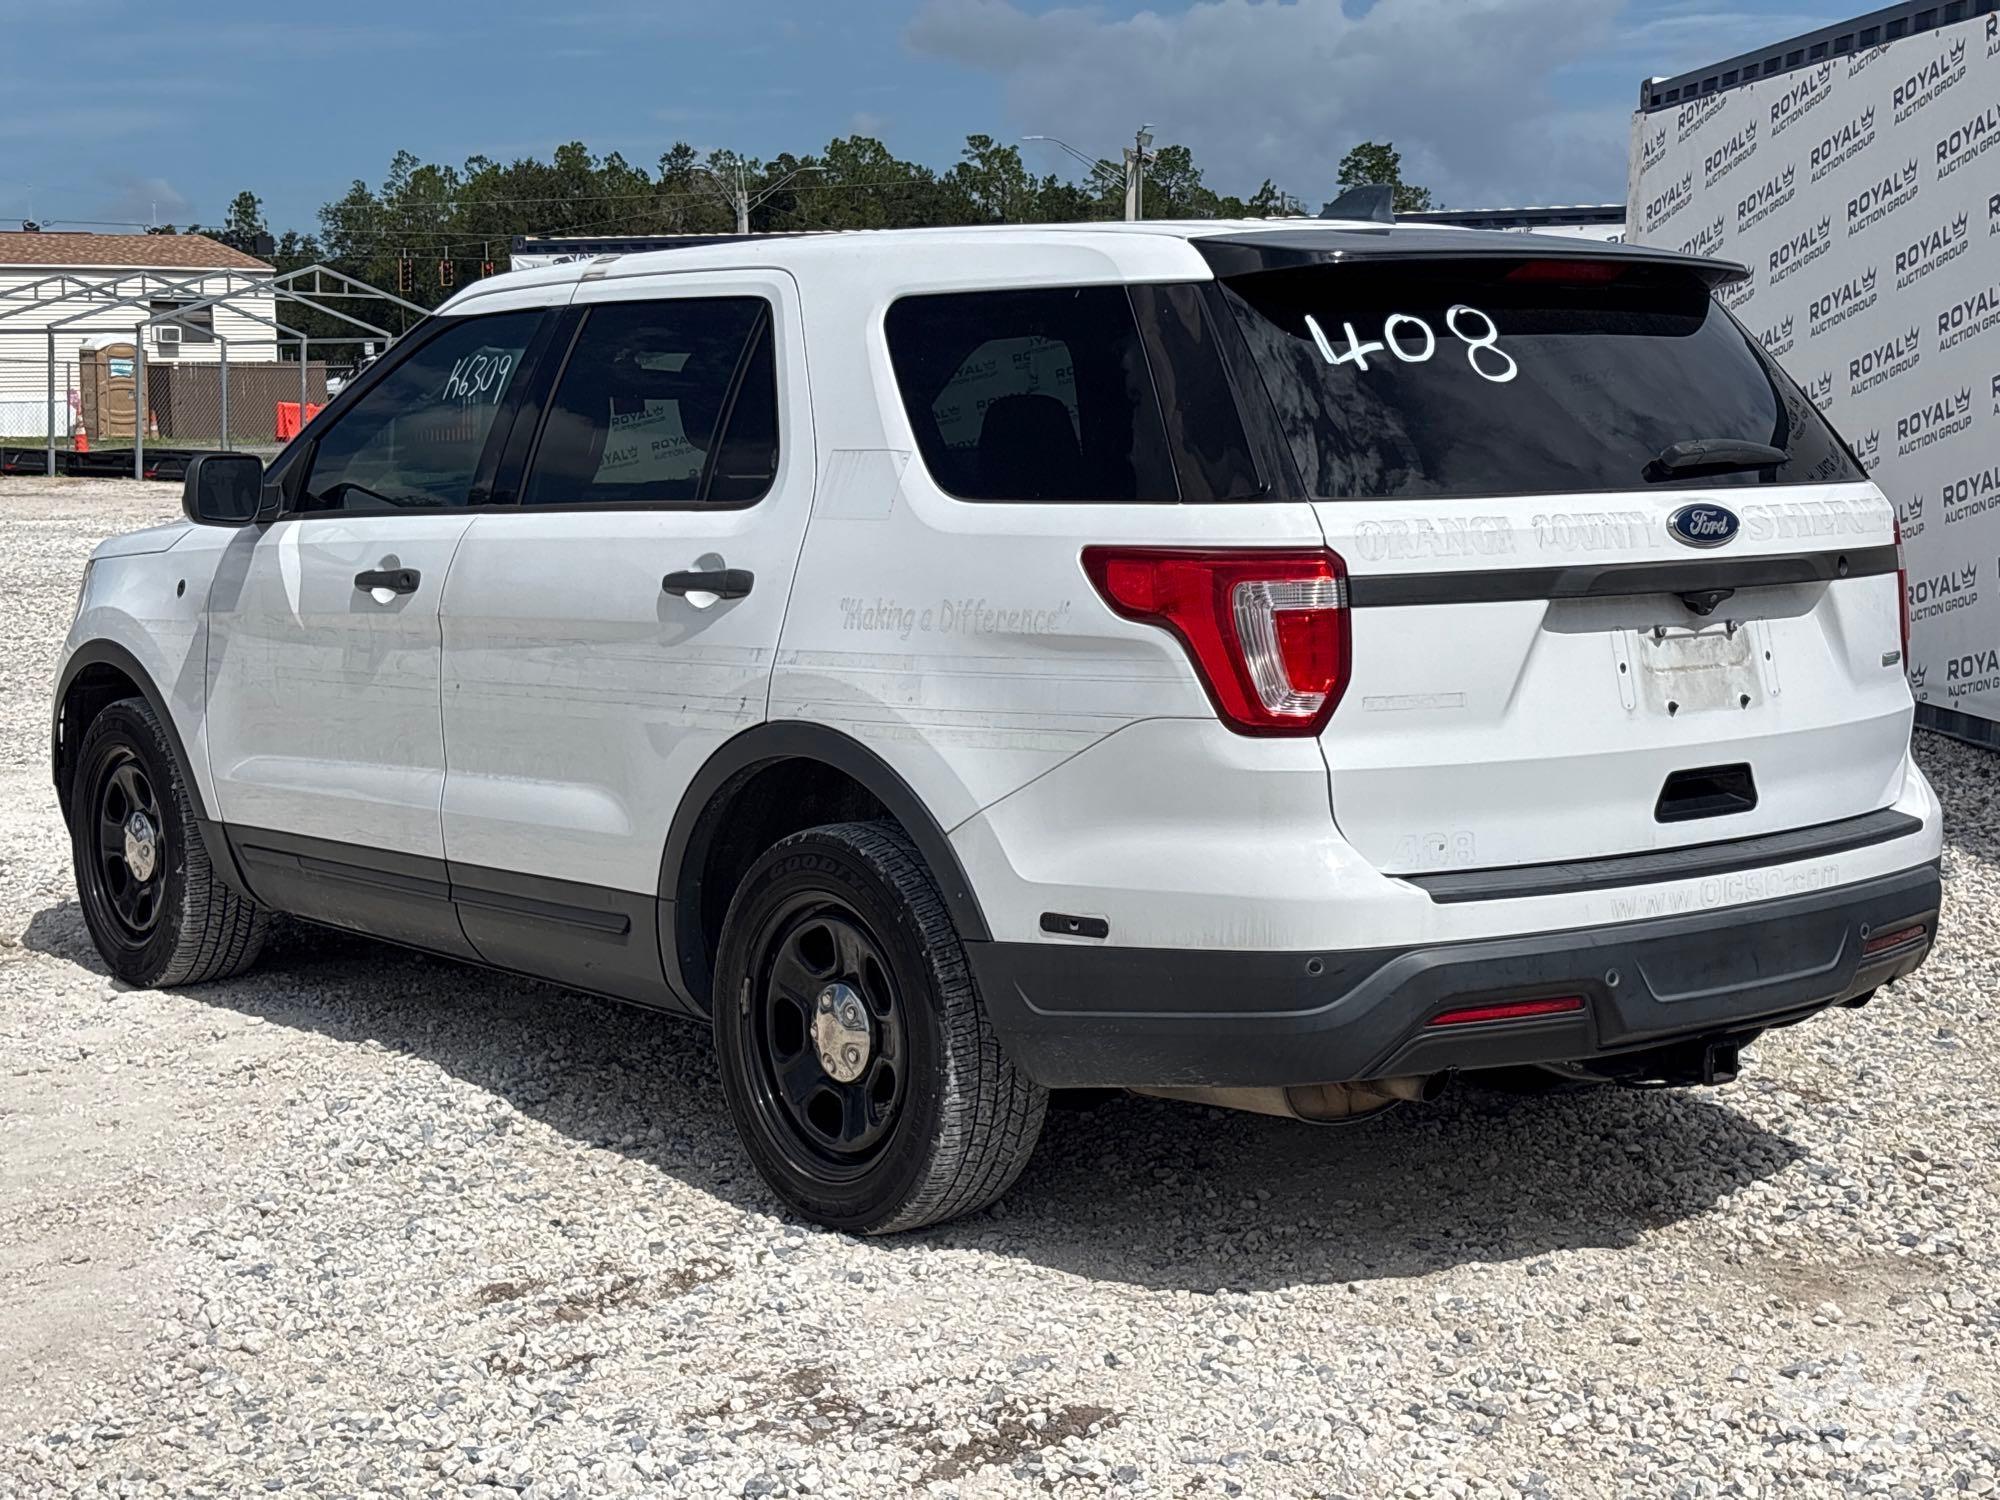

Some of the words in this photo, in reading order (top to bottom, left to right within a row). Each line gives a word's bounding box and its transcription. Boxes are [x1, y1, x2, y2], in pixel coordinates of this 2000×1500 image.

[1771, 74, 1818, 124] ROYAL
[1893, 54, 1950, 110] ROYAL
[1894, 89, 1933, 126] AUCTION
[1933, 65, 1966, 98] GROUP
[1678, 94, 1717, 132] ROYA
[1678, 116, 1704, 144] AUCTION
[1704, 97, 1727, 121] GROUP
[1771, 107, 1804, 138] AUCTION
[1804, 85, 1831, 113] GROUP
[1704, 131, 1746, 176] ROYAL
[1811, 120, 1861, 169] ROYAL
[1811, 152, 1845, 184] AUCTION
[1845, 131, 1875, 159] GROUP
[1936, 109, 1998, 164] ROYAL
[1937, 145, 1978, 182] AUCTION
[1976, 130, 2000, 153] GRO
[1705, 161, 1733, 190] AUCTION
[1733, 142, 1757, 168] GROUP
[1646, 182, 1682, 221] ROYAL
[1671, 193, 1692, 216] GROUP
[1738, 177, 1782, 221] ROYAL
[1738, 204, 1769, 234] AUCTION
[1769, 188, 1795, 213] GROUP
[1848, 173, 1903, 222] ROYAL
[1848, 204, 1887, 238] AUCTION
[1887, 185, 1918, 214] GROUP
[1769, 228, 1817, 272] ROYAL
[1770, 258, 1803, 286] AUCTION
[1803, 240, 1831, 267] GROUP
[1895, 226, 1952, 275] ROYAL
[1896, 259, 1935, 291] AUCTION
[1936, 239, 1968, 268] GROUP
[1731, 288, 1755, 311] GROUP
[1809, 279, 1862, 323] ROYAL
[1810, 307, 1846, 338] AUCTION
[1847, 293, 1877, 318] GROUP
[1938, 287, 2000, 336] ROYAL
[1304, 304, 1517, 382] 408
[1939, 321, 1980, 352] AUCTION
[1982, 310, 2000, 331] GRO
[442, 354, 512, 404] K6309
[1850, 337, 1904, 382] ROYAL
[1850, 368, 1889, 398] AUCTION
[1889, 353, 1920, 377] GROUP
[1897, 398, 1955, 441] ROYAL
[1898, 428, 1938, 457] AUCTION
[1939, 415, 1972, 440] GROUP
[651, 436, 689, 452] ROYA
[1943, 466, 2000, 508] ROYAL
[1689, 509, 1729, 536] Ford
[1900, 523, 1924, 540] ROUP
[1945, 499, 1987, 525] AUCTION
[919, 612, 932, 631] a
[1910, 602, 1944, 622] UCTION
[1945, 592, 1978, 612] GROUP
[1947, 650, 1999, 681] ROYA
[1948, 677, 1991, 698] AUCTION
